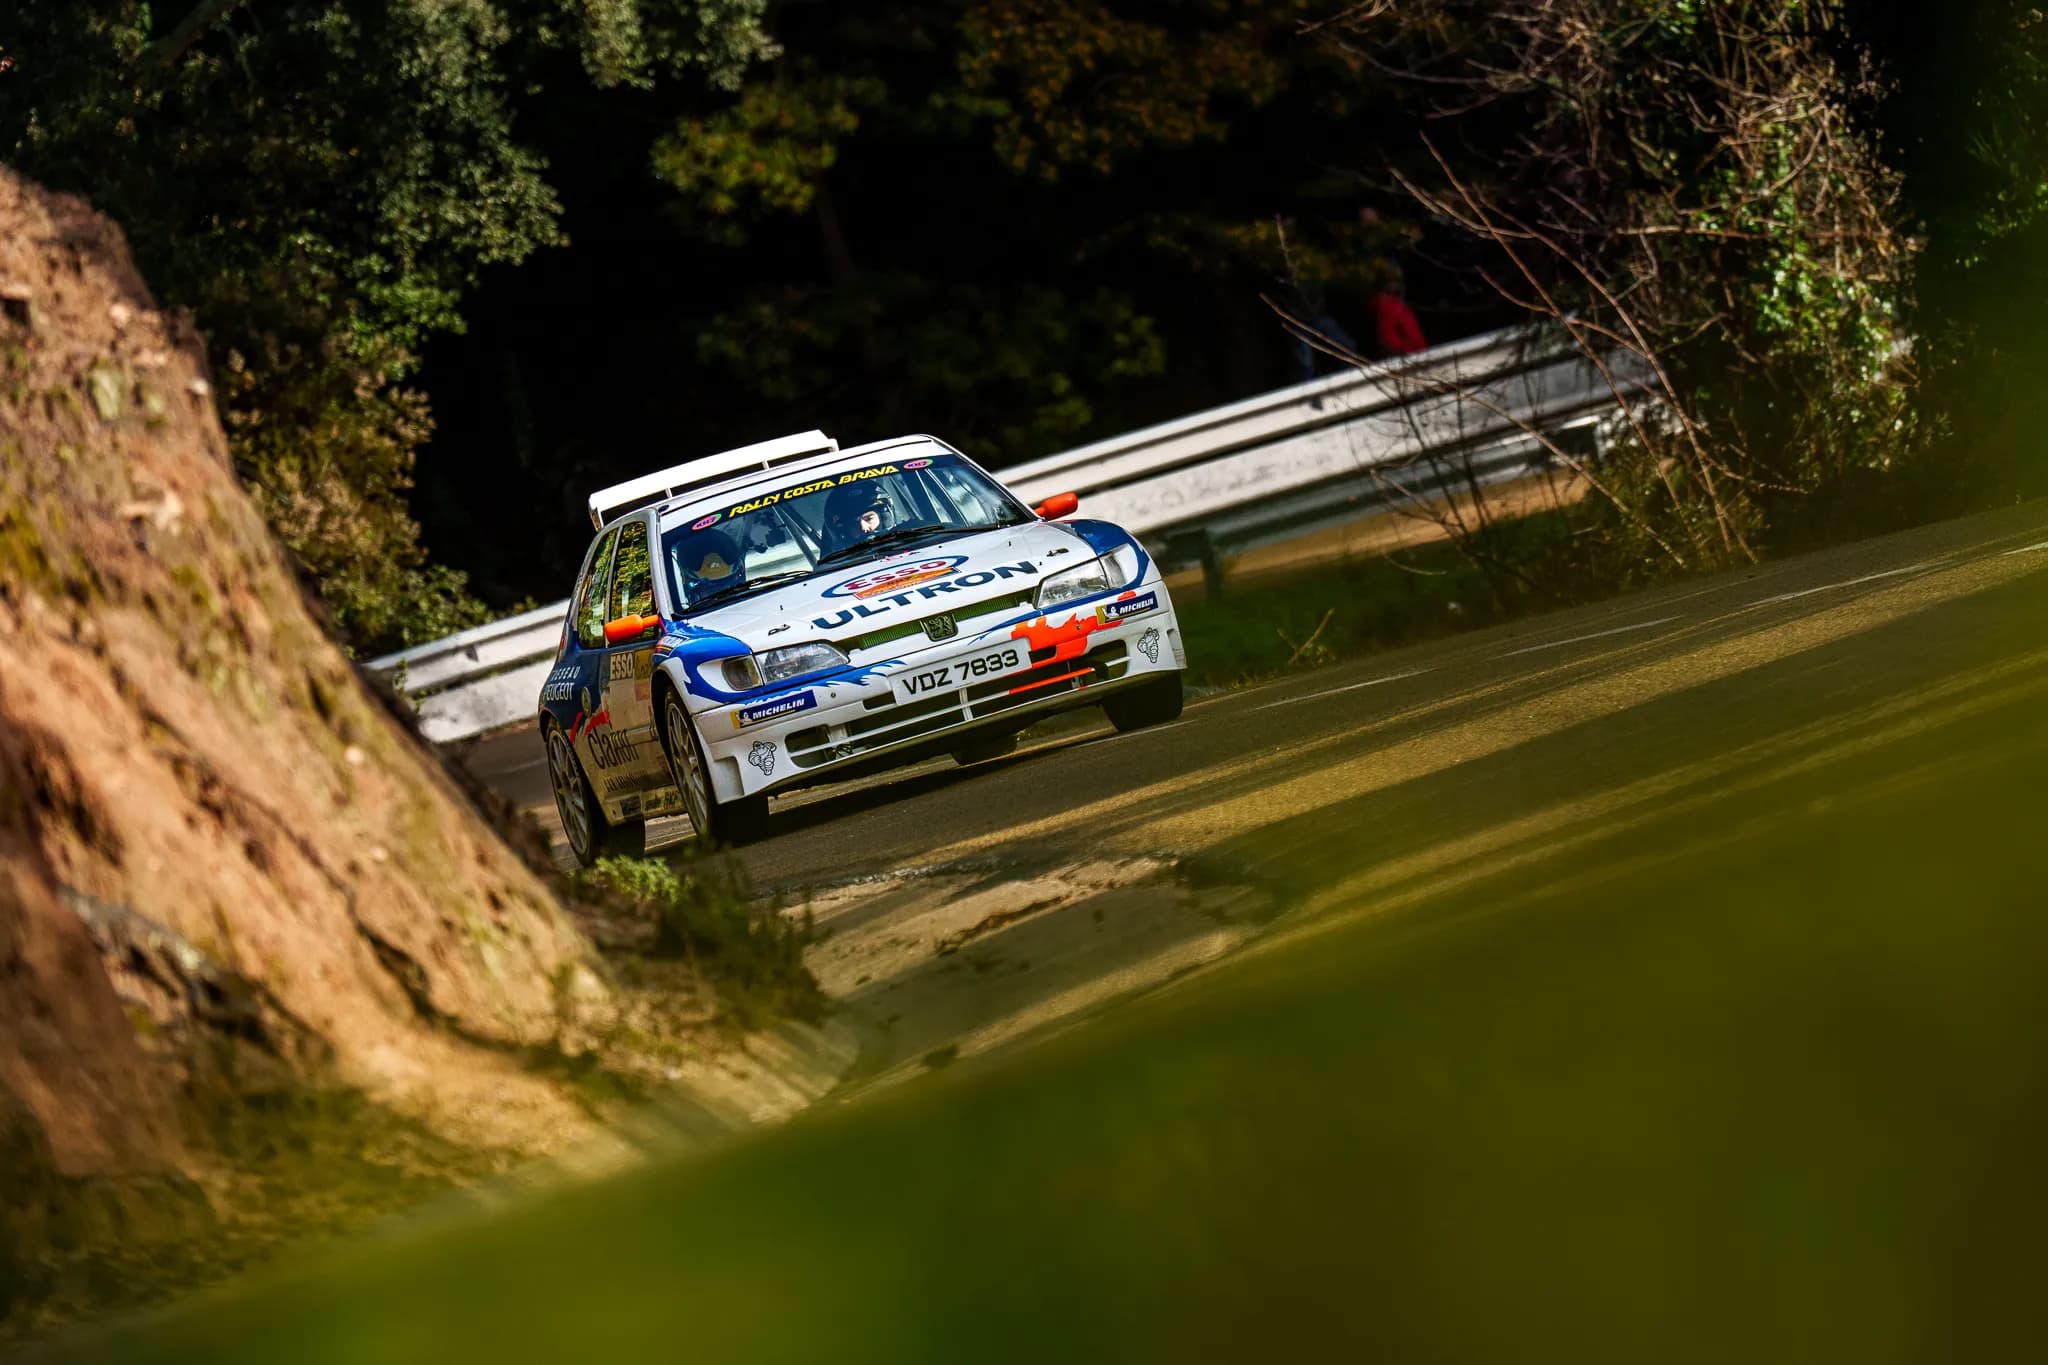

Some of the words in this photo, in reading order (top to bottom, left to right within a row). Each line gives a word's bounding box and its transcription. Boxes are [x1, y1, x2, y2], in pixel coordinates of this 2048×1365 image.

[729, 493, 780, 518] RALLY
[784, 479, 836, 499] COSTA
[838, 465, 899, 485] BRAVA
[844, 560, 947, 590] ESSO
[812, 560, 1039, 630] ULTRON
[1119, 598, 1154, 614] MICHELIN
[610, 652, 634, 680] ESSO
[902, 672, 952, 695] VDZ
[954, 649, 1019, 680] 7833
[543, 682, 575, 701] PEUGEOT
[752, 698, 805, 720] MICHELIN
